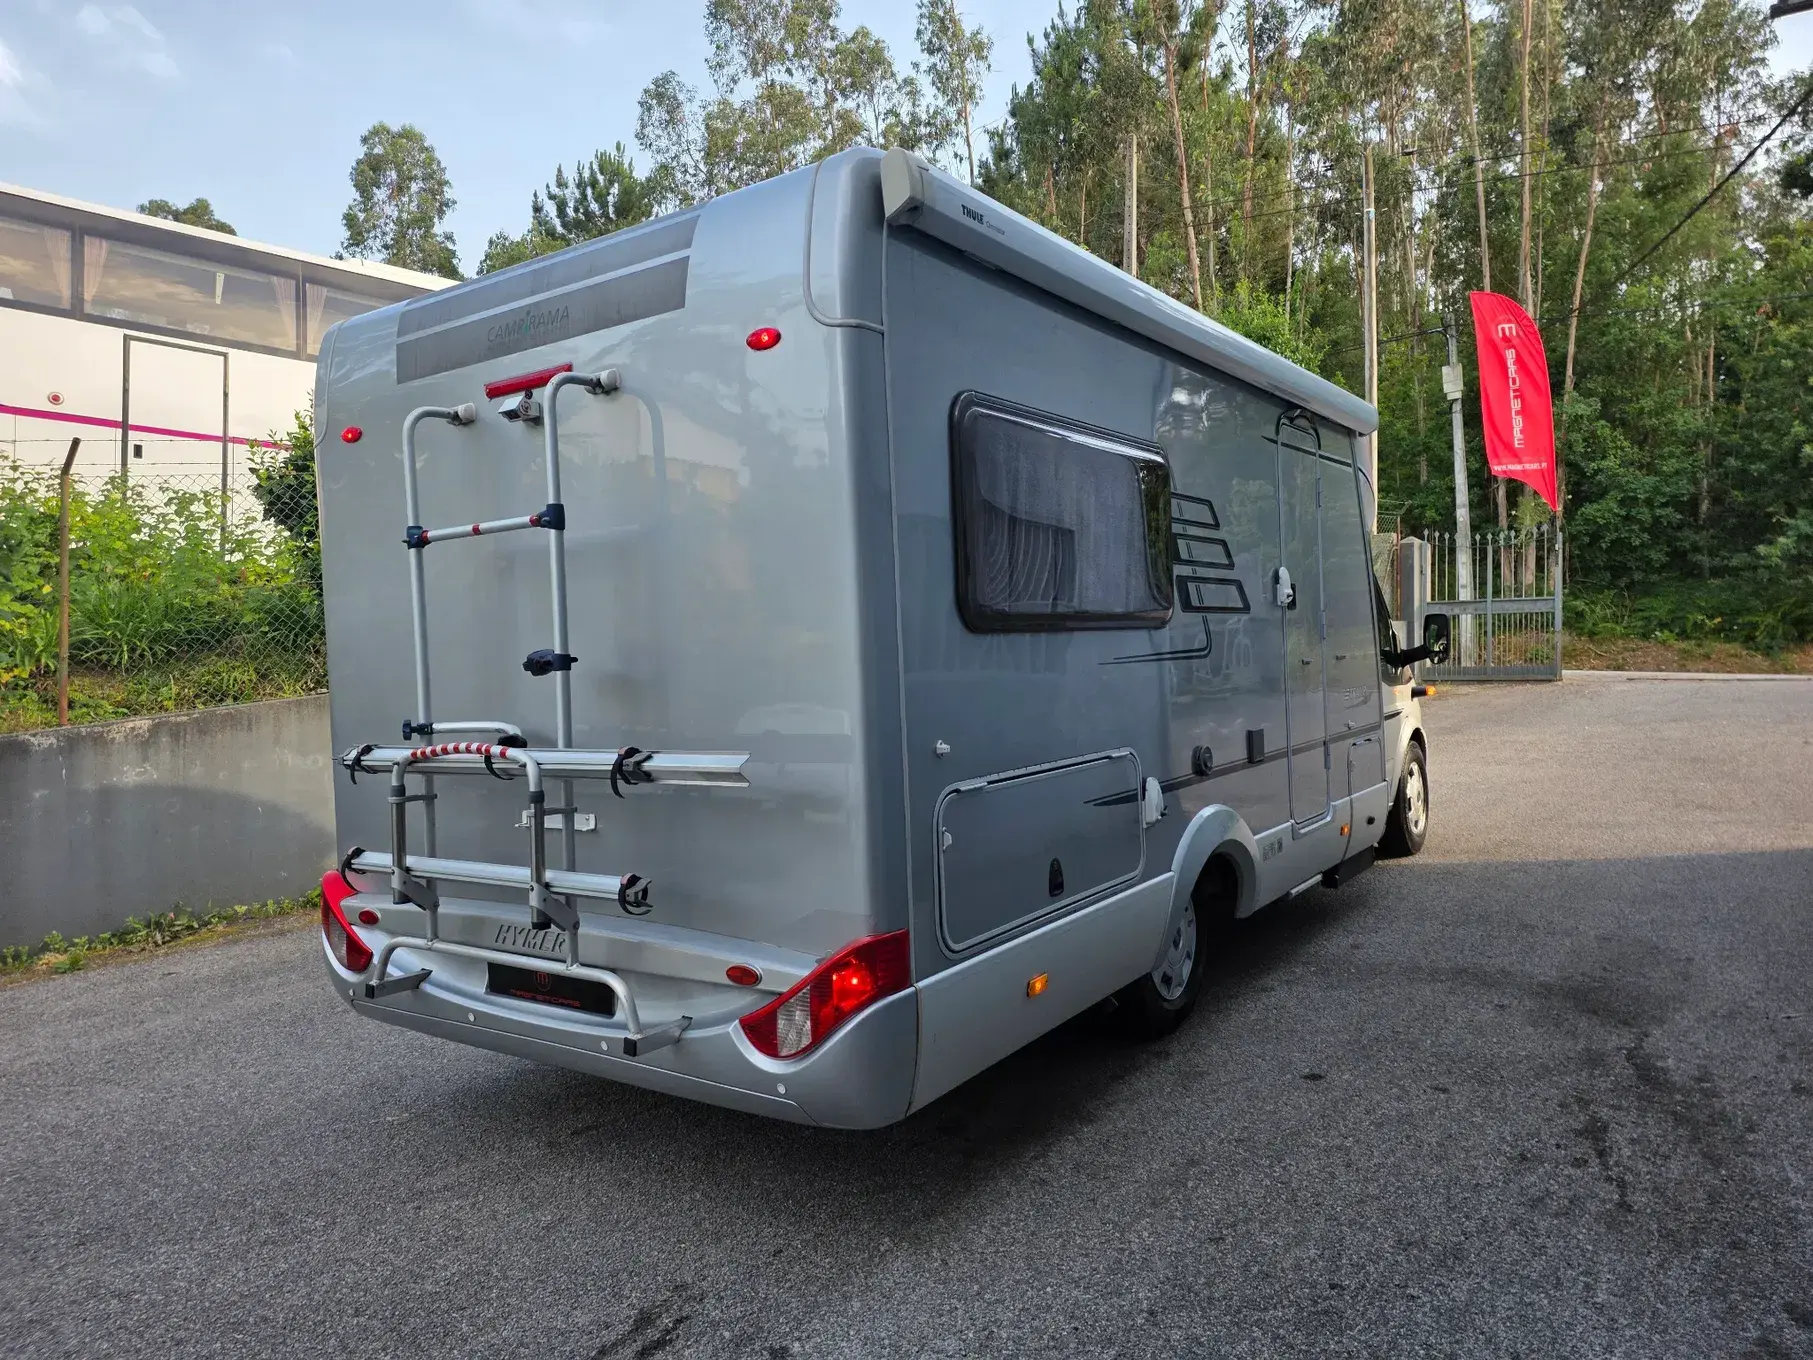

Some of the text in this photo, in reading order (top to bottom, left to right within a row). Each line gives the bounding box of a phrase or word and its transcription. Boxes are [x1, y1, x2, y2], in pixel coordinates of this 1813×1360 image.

[961, 204, 984, 225] THULE
[1505, 349, 1525, 448] MAGNETICARS
[494, 924, 566, 953] HYMER
